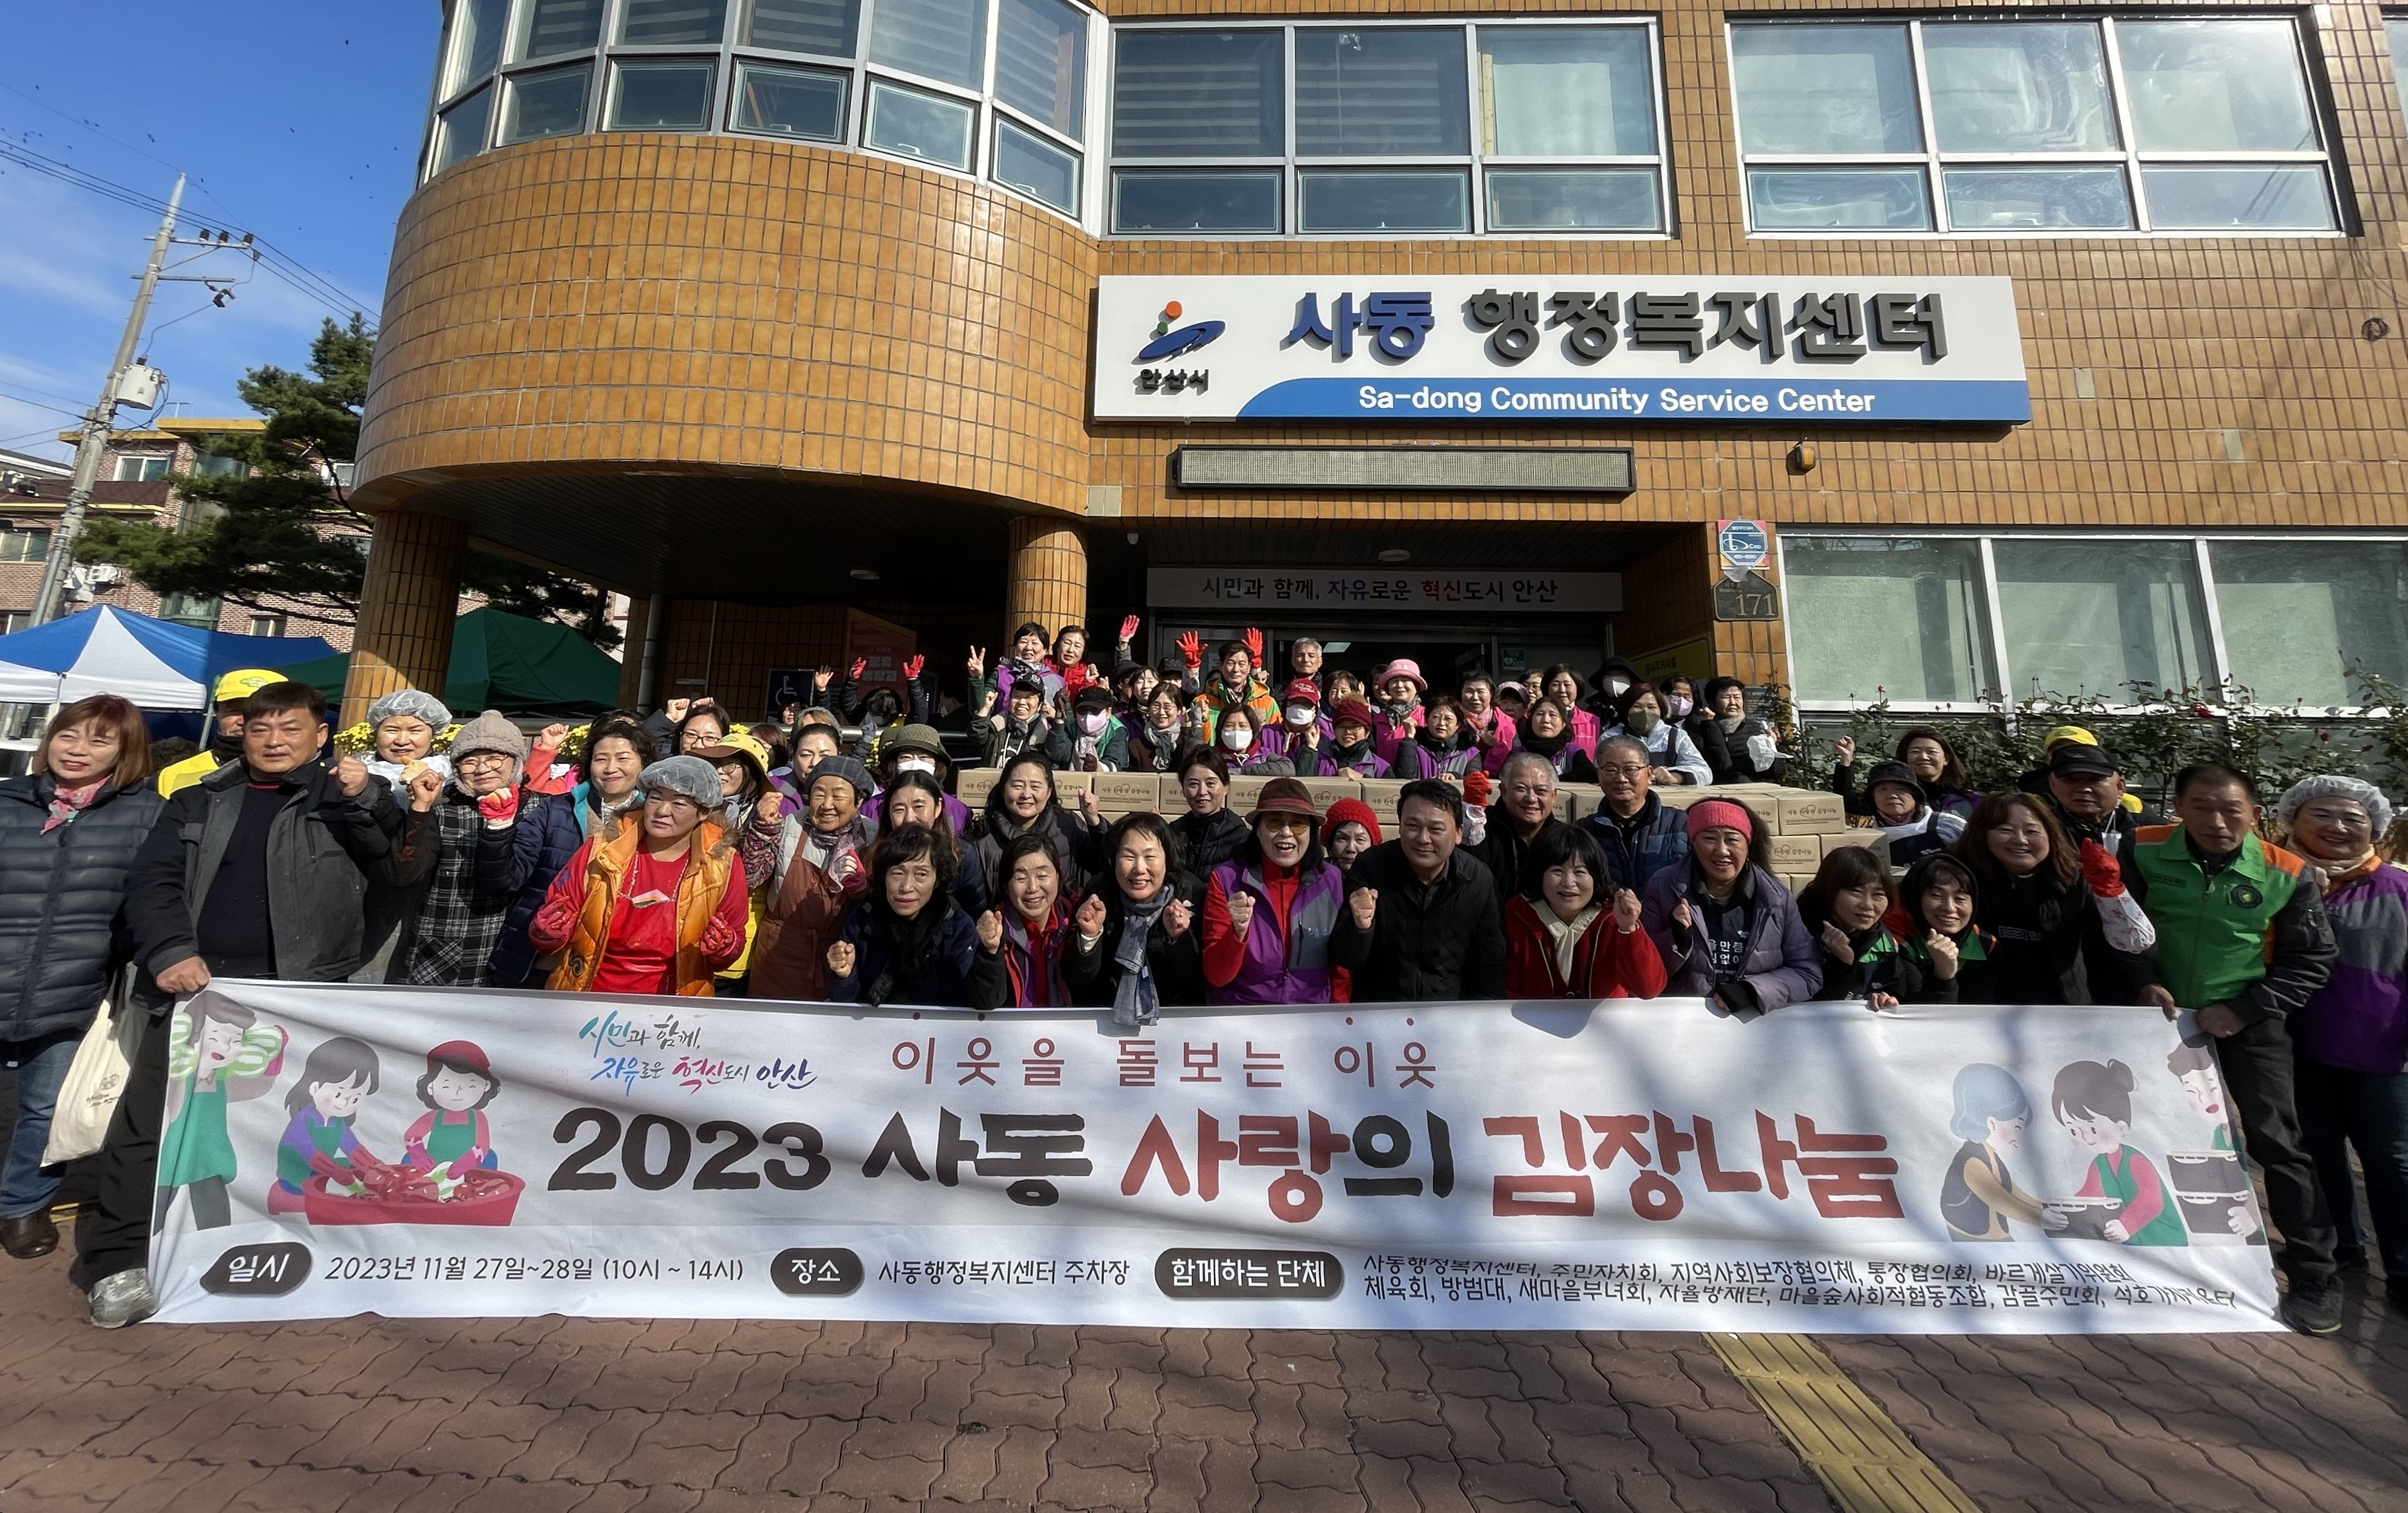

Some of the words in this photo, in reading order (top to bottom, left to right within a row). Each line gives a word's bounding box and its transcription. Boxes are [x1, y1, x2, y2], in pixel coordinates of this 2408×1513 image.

[1289, 291, 1435, 360] 사동
[1471, 288, 1948, 361] 행정복지센터
[1140, 368, 1209, 391] 안산시
[1358, 386, 1482, 413] Sa-dong
[1491, 387, 1649, 415] Community
[1660, 387, 1769, 413] Service
[1778, 388, 1876, 413] Center
[1202, 577, 1264, 599] 시민과
[1273, 578, 1320, 601] 함께,
[1328, 579, 1413, 602] 자유로운
[1421, 579, 1504, 603] 혁신도시
[1511, 580, 1559, 604] 안산
[1735, 594, 1775, 616] 171
[578, 1010, 651, 1058] 시민과
[590, 1056, 665, 1097] 자유로운
[671, 1056, 751, 1094] 혁신도시
[756, 1058, 818, 1089] 안산
[547, 1106, 832, 1192] 2023
[861, 1105, 1094, 1206] 사동
[1120, 1107, 1455, 1223] 사랑의
[1482, 1108, 1906, 1222] 김장나눔
[228, 1253, 290, 1284] 일시
[324, 1256, 415, 1281] 2023년
[422, 1256, 467, 1282] 11월
[473, 1257, 593, 1281] 27일~28일
[603, 1258, 660, 1281] (10시
[688, 1258, 744, 1282] 14시)
[791, 1258, 841, 1284] 장소
[878, 1260, 1056, 1286] 사동행정복지센터
[1063, 1260, 1130, 1287] 주차장
[1170, 1258, 1269, 1288] 함께하는
[1276, 1259, 1326, 1288] 단체
[1363, 1254, 1542, 1278] 사동행정복지센터,
[1550, 1262, 1663, 1284] 주민자치회,
[1671, 1260, 1864, 1286] 지역사회보장협의체,
[1868, 1262, 1976, 1284] 통장협의회,
[1986, 1262, 2137, 1284] 바르게살기위원회
[1364, 1275, 1436, 1302] 체육회,
[1441, 1276, 1513, 1304] 방범대,
[1519, 1279, 1652, 1305] 새마을부녀회,
[1659, 1283, 1771, 1306] 자율방재단,
[1779, 1283, 1995, 1310] 마을숲사회적협동조합,
[1996, 1284, 2106, 1308] 감골주민회,
